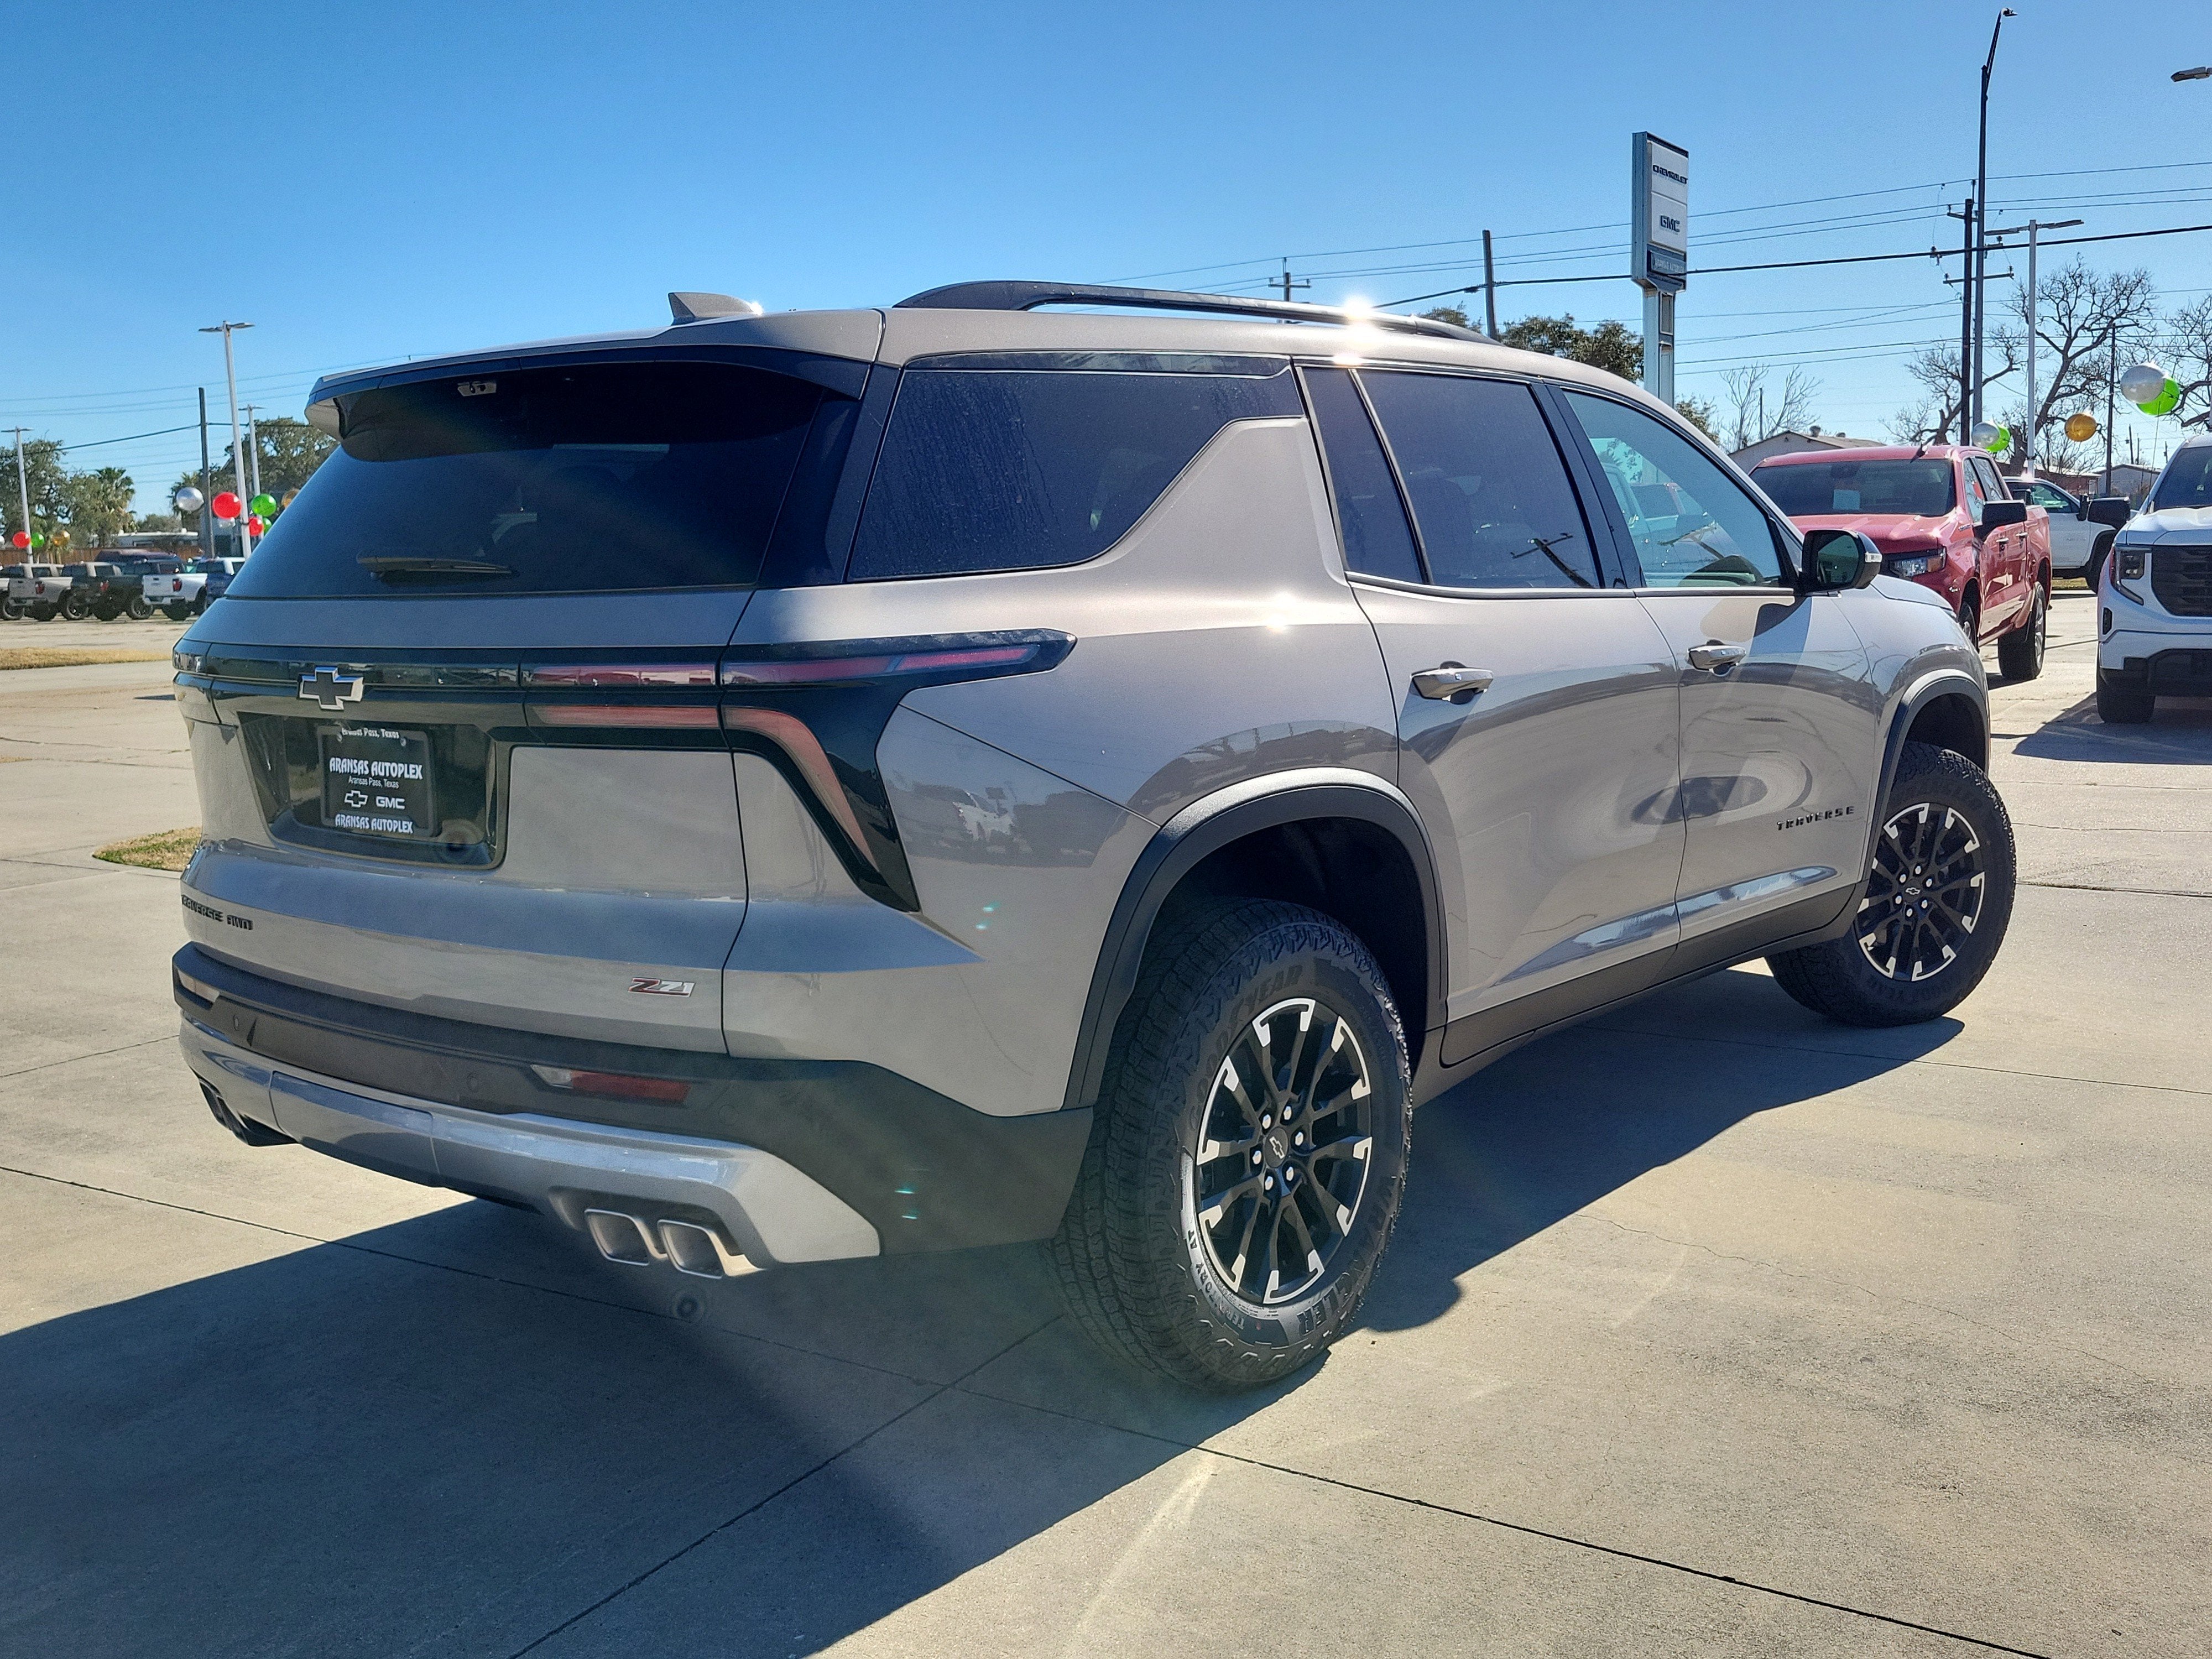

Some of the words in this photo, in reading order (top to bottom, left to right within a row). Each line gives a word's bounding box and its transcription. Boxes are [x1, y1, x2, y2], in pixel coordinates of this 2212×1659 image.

[1653, 165, 1688, 184] CHEVROLET
[1661, 215, 1680, 233] GMC
[380, 729, 400, 739] Texas
[330, 757, 369, 776] ARANSAS
[371, 761, 423, 780] AUTOPLEX
[348, 775, 368, 786] Aransas
[368, 777, 383, 787] Pass,
[384, 779, 399, 789] Texas
[375, 796, 405, 809] GMC
[335, 813, 370, 830] ARANSAS
[371, 818, 414, 834] AUTOPLEX
[1777, 806, 1855, 831] TRAVERSE
[181, 894, 223, 922] RAVERSE
[628, 977, 696, 998] Z71
[1189, 964, 1303, 1130] GOODYEAR
[1188, 1229, 1197, 1250] AT
